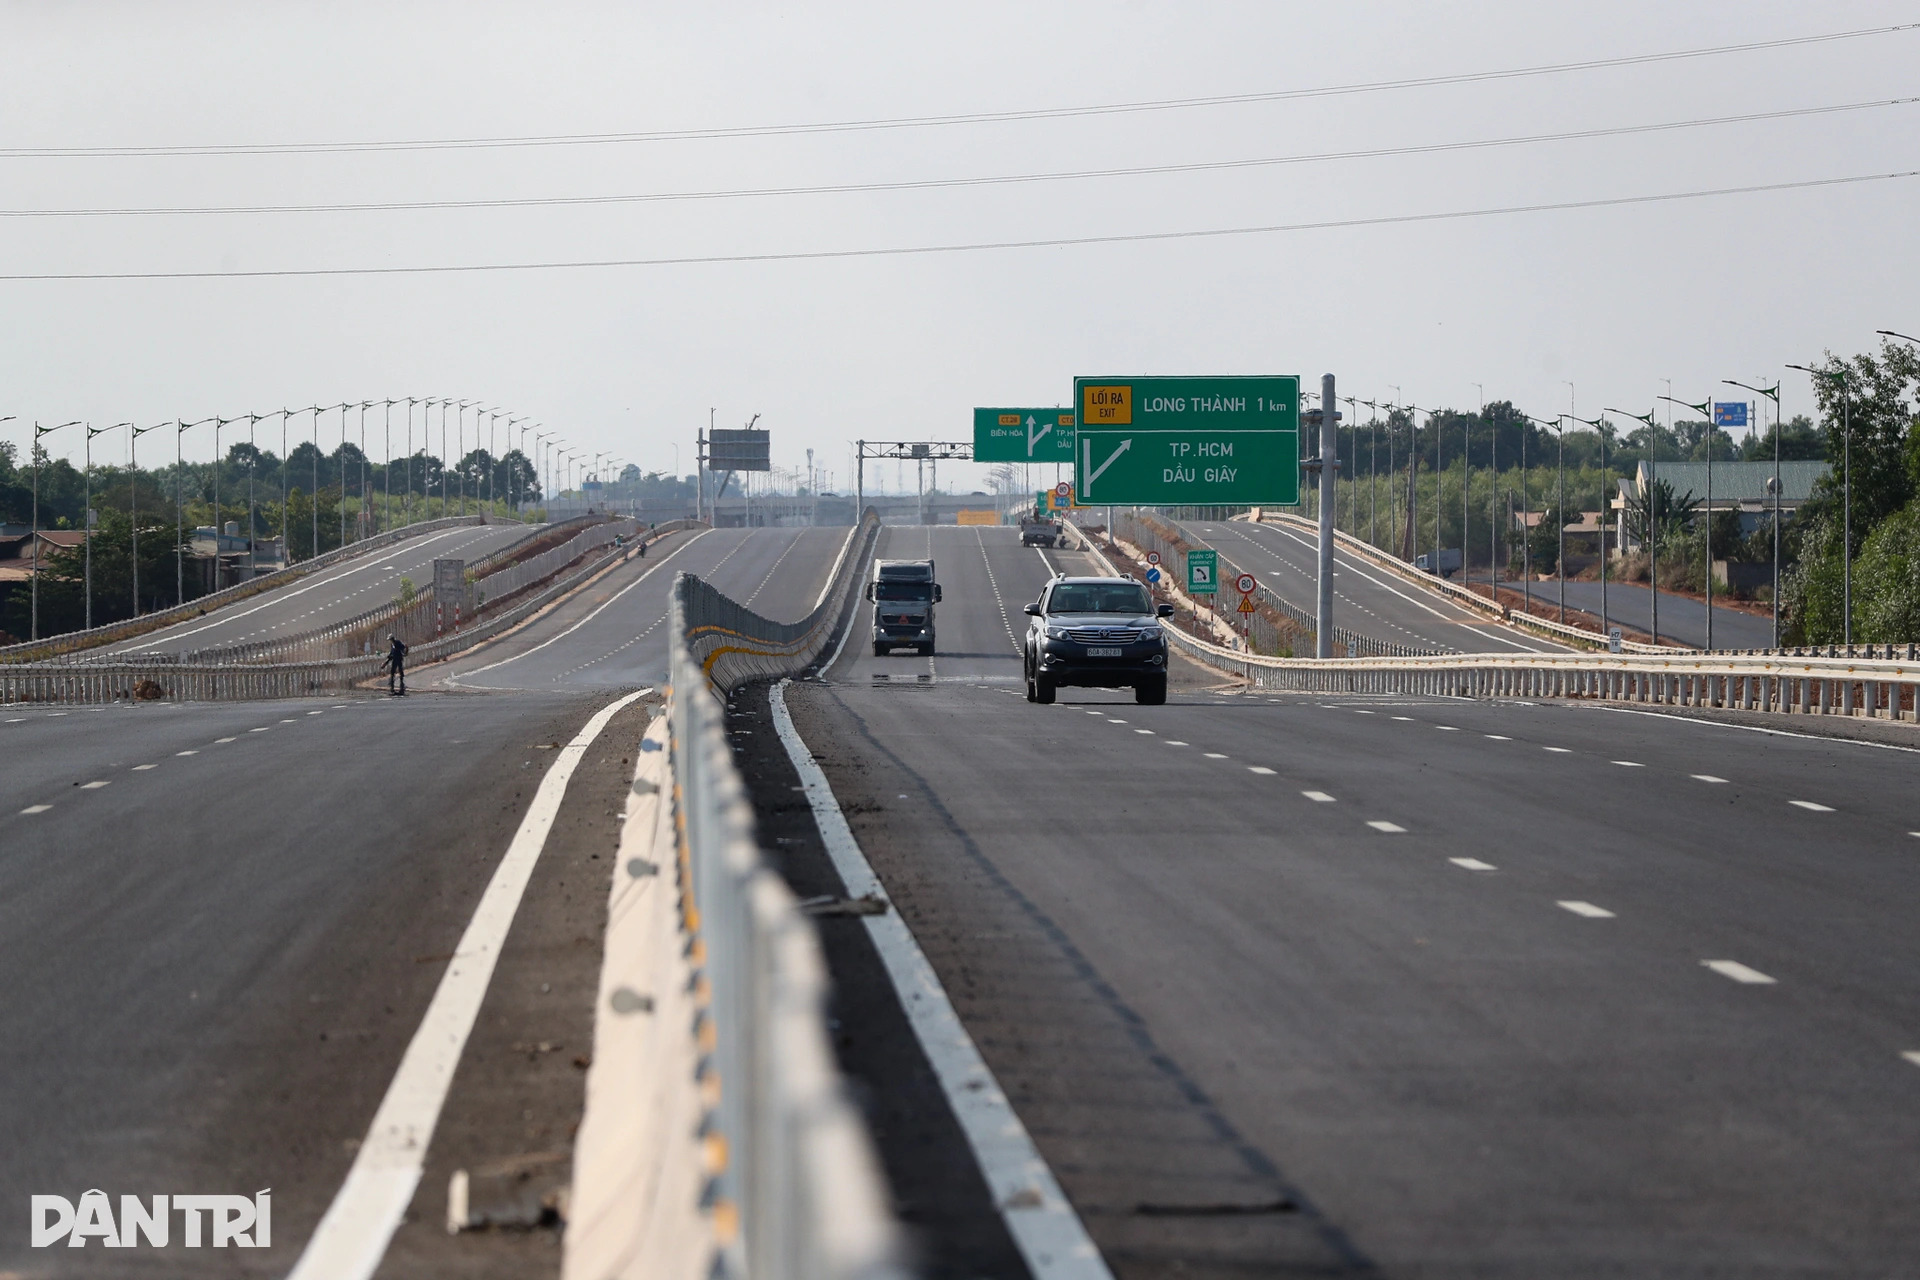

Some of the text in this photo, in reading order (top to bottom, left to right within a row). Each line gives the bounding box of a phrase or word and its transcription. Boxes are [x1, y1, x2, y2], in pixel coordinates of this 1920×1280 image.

[1091, 389, 1124, 405] LỐI RA
[1143, 393, 1287, 412] LONG THÀNH 1 km
[1099, 408, 1116, 418] EXIT
[1169, 442, 1233, 457] TP.HCM
[1163, 462, 1238, 483] DẦU GIÂY
[1241, 579, 1251, 589] 80
